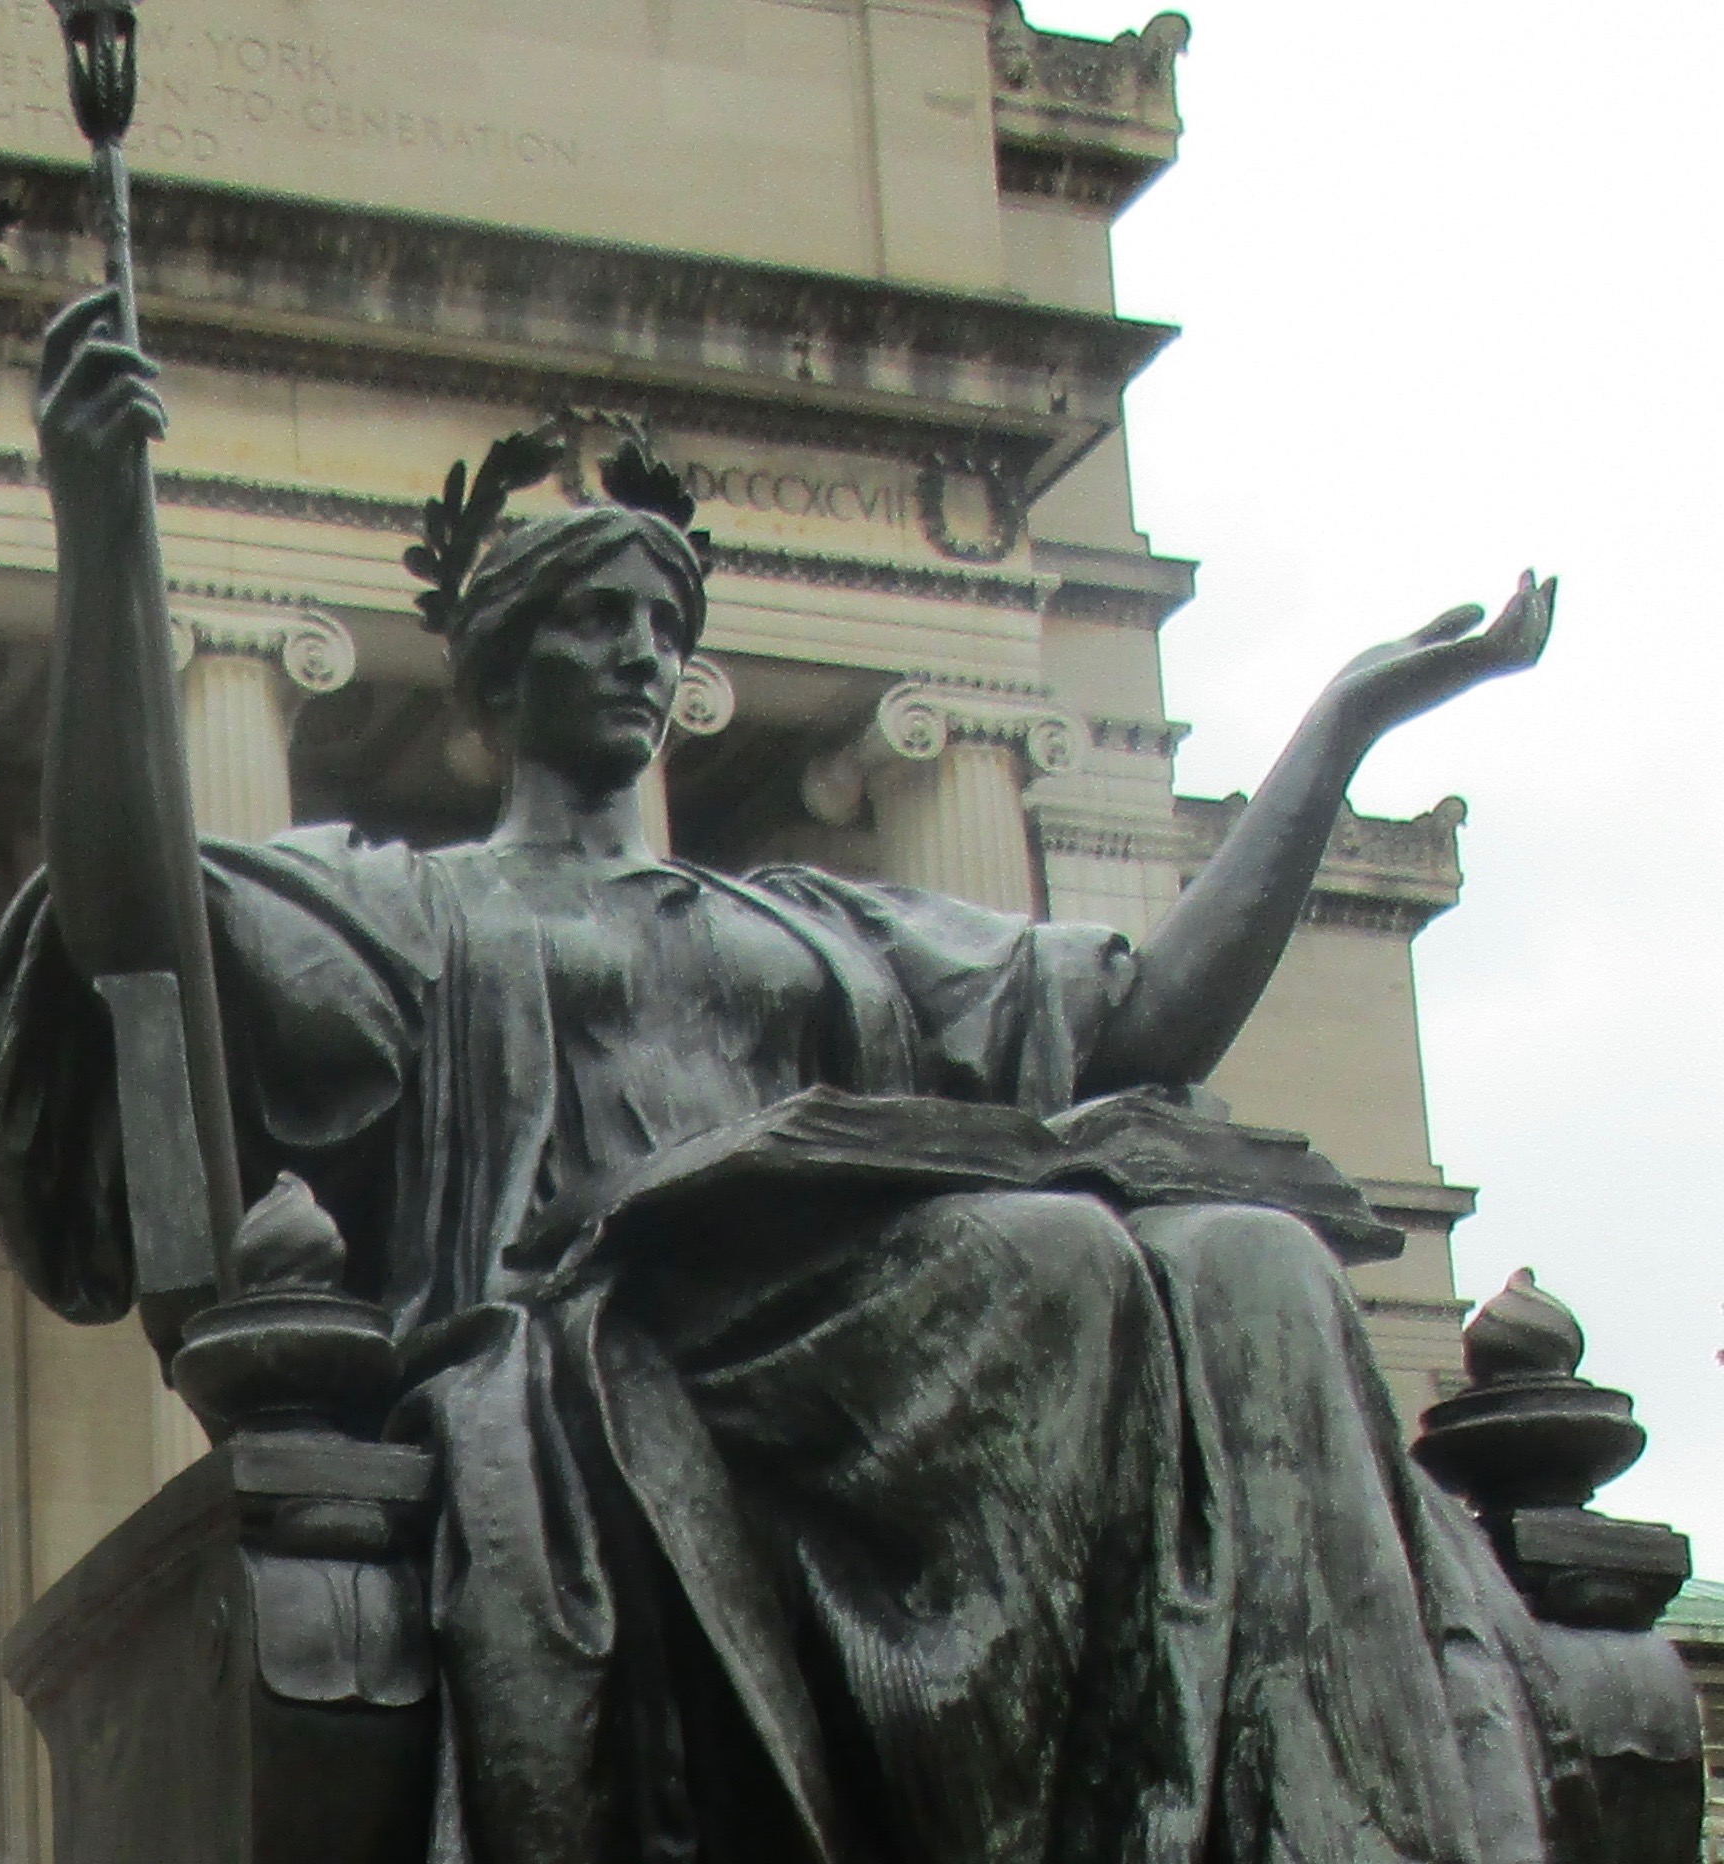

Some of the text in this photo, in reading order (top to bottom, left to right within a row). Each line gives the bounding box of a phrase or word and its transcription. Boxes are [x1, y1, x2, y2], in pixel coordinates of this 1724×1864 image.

[202, 27, 340, 88] YORK
[213, 83, 275, 124] TO
[301, 98, 579, 169] GENERATION
